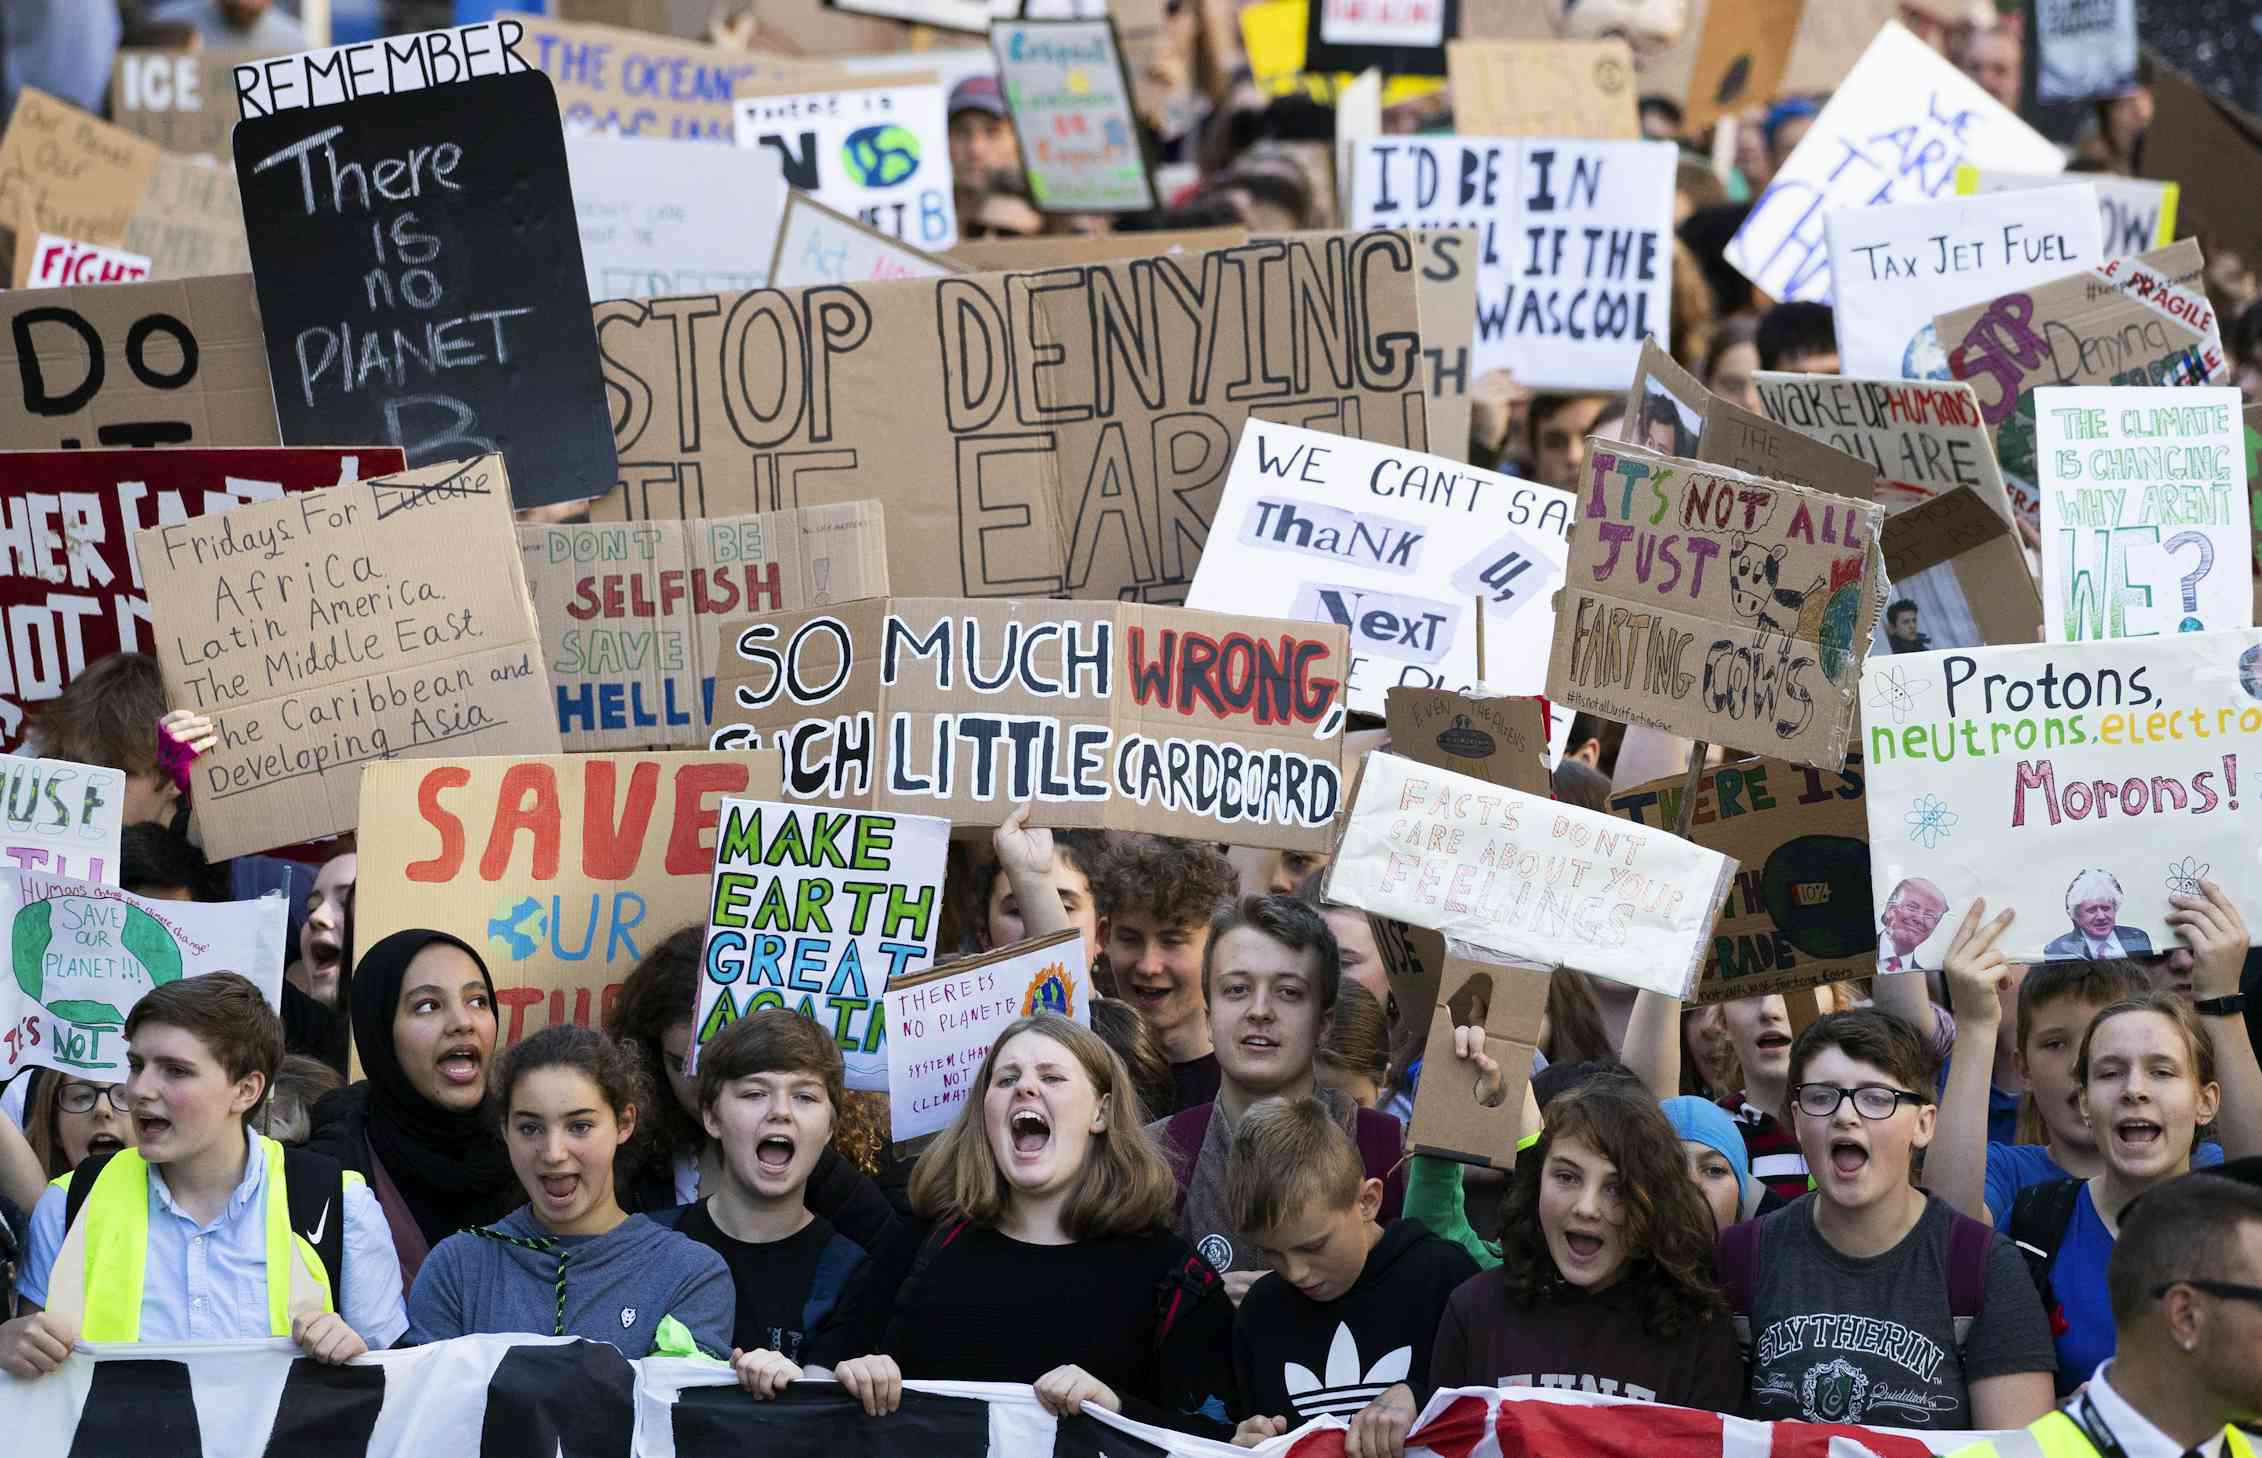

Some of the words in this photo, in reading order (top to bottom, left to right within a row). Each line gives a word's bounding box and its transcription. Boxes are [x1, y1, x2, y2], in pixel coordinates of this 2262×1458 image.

[122, 54, 201, 111] ICE
[233, 20, 532, 120] REMEMBER
[534, 34, 616, 92] THE
[253, 126, 462, 215] There
[1458, 149, 1500, 207] BE
[1526, 151, 1604, 211] IN
[1524, 227, 1567, 277] IF
[1583, 228, 1657, 280] THE
[592, 287, 872, 456] STOP
[937, 231, 1422, 433] DENYING
[2051, 404, 2109, 440] THE
[2120, 403, 2230, 438] CLIMATE
[1258, 434, 1332, 484] WE
[1369, 457, 1494, 513] CAN'T
[1507, 489, 1569, 536] SA
[1901, 432, 1981, 486] ARE
[2055, 448, 2082, 480] IS
[2088, 445, 2232, 481] CHANGING
[161, 515, 295, 571] Fridays
[301, 493, 358, 535] For
[1684, 478, 1771, 530] NOT
[1786, 499, 1863, 549] ALL
[2055, 488, 2127, 528] WHY
[711, 521, 762, 565] BE
[1592, 521, 1721, 600] JUST
[566, 562, 783, 620] SELFISH
[177, 618, 288, 667] Latin
[184, 668, 249, 708] The
[265, 625, 385, 687] Middle
[553, 629, 685, 675] SAVE
[735, 616, 854, 708] SO
[881, 614, 1114, 698] MUCH
[1569, 596, 1698, 700] FARTING
[209, 717, 263, 754] he
[281, 666, 475, 732] Caribbean
[490, 654, 534, 683] and
[1702, 638, 1816, 741] COWS
[1942, 655, 2163, 718] Protons,
[209, 724, 392, 795] Developing
[409, 700, 496, 744] Asia
[889, 712, 1114, 804] LITTLE
[1112, 734, 1343, 826] CARDBOARD
[404, 760, 750, 884] SAVE
[1398, 777, 1524, 832] FACTS
[2011, 753, 2241, 829] Morons!
[718, 805, 897, 872] MAKE
[1389, 819, 1466, 855] CARE
[1479, 839, 1592, 888] ABOUT
[1600, 866, 1684, 919] YOUR
[62, 898, 123, 930] SAVE
[711, 871, 936, 942] EARTH
[1379, 851, 1636, 947] FEELINGS
[705, 930, 928, 998] GREAT
[898, 980, 974, 1017] THERE
[903, 1019, 924, 1038] NO
[939, 1001, 1001, 1032] PLANET
[1005, 997, 1016, 1014] B
[908, 1052, 955, 1079] SYSTEM
[943, 1067, 972, 1088] NOT
[1758, 1313, 1945, 1383] SLYTHERIN
[1766, 1372, 1796, 1390] Team
[1870, 1382, 1929, 1405] Quidditch
